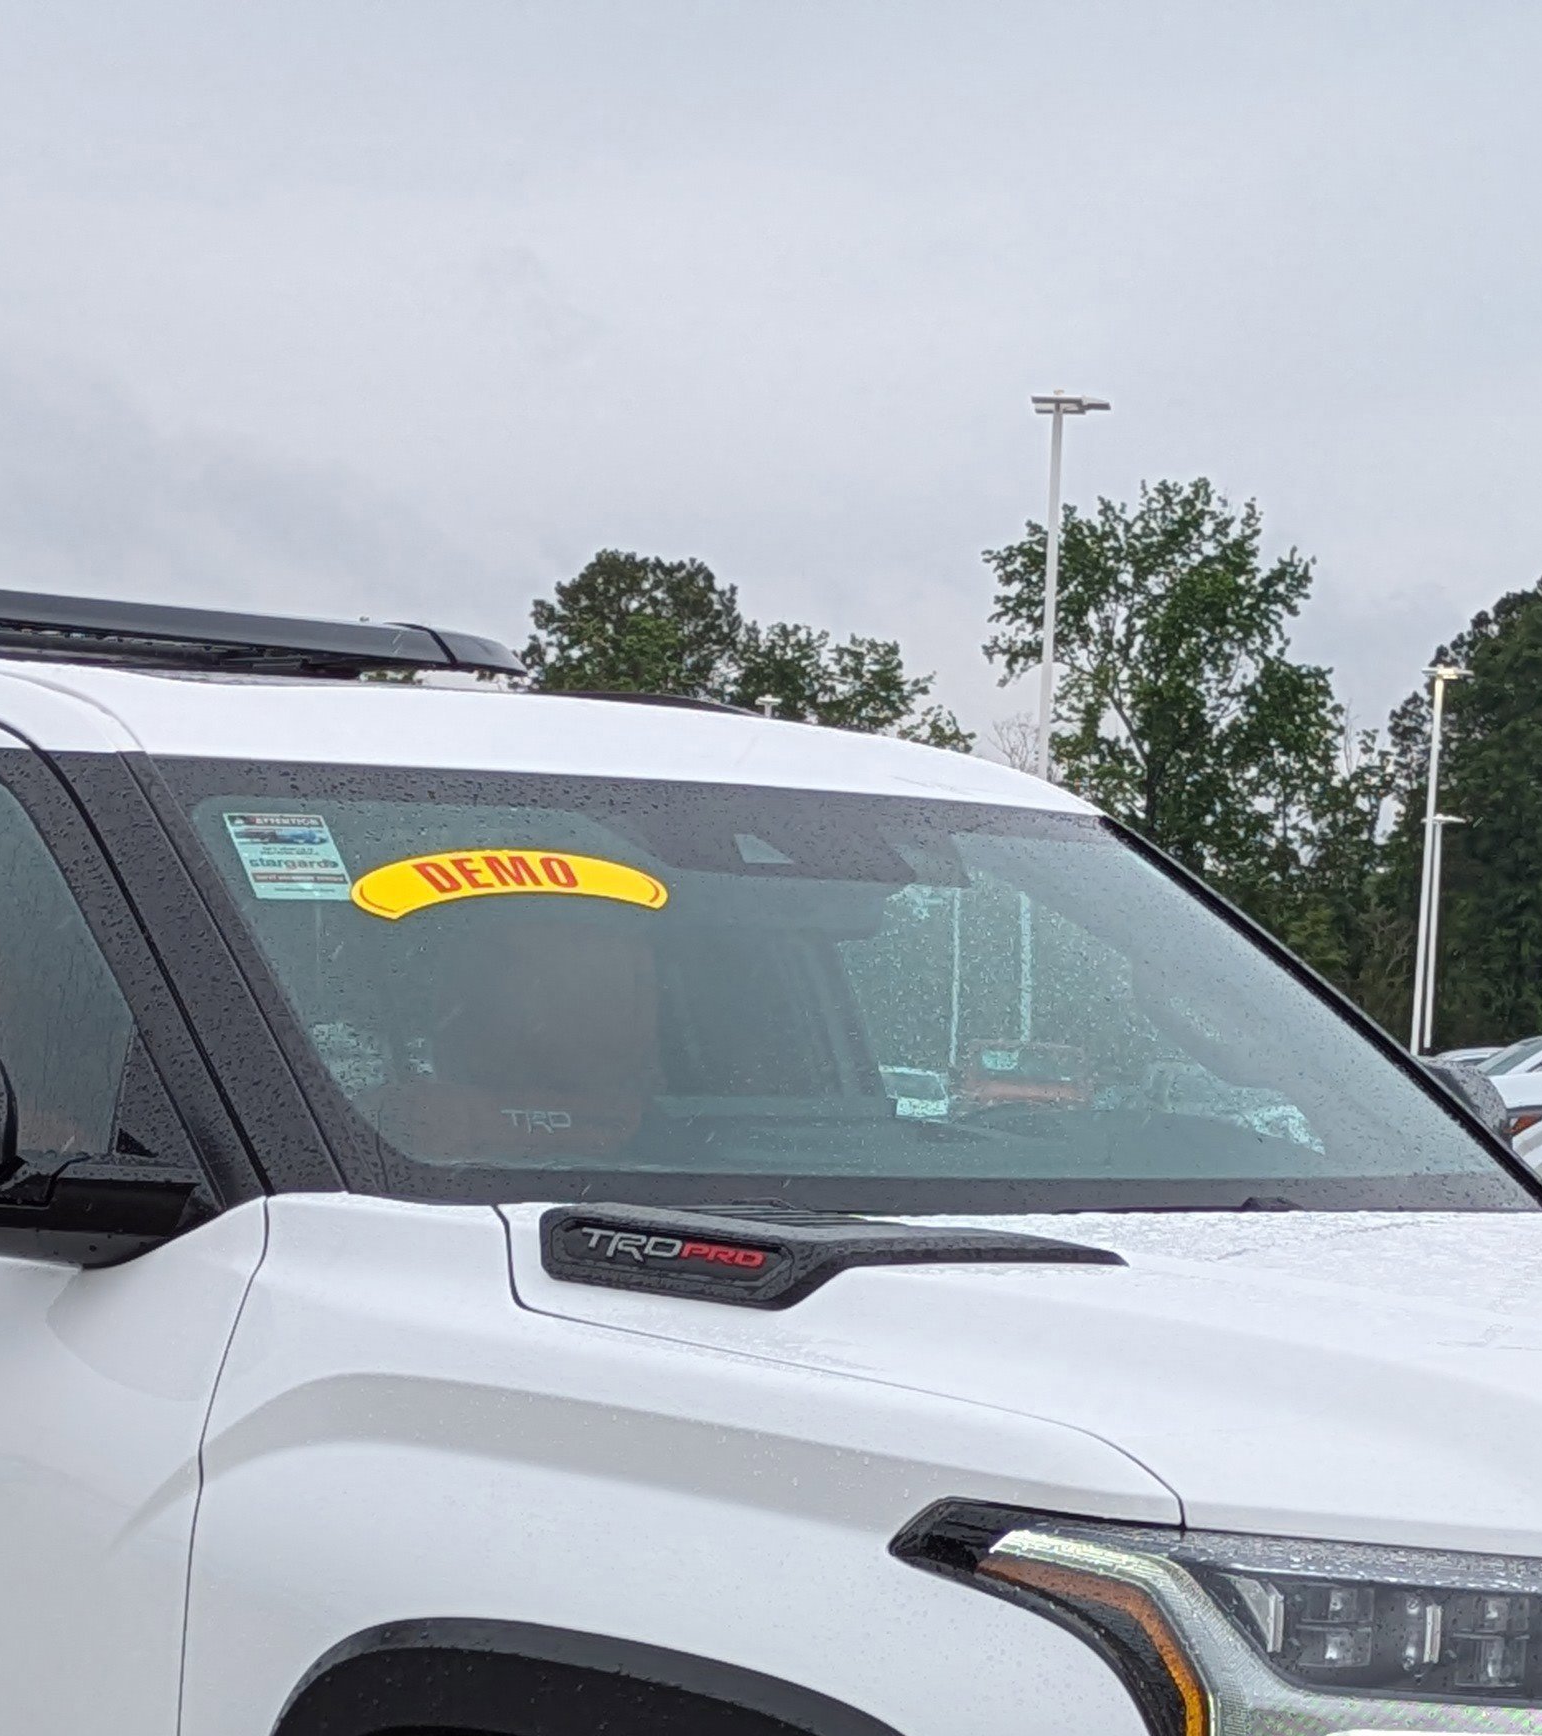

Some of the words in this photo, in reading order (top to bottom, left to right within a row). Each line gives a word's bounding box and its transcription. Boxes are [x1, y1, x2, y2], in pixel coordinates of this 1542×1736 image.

[412, 856, 578, 893] DEMO
[501, 1109, 571, 1134] TRD
[582, 1227, 683, 1262] TRD
